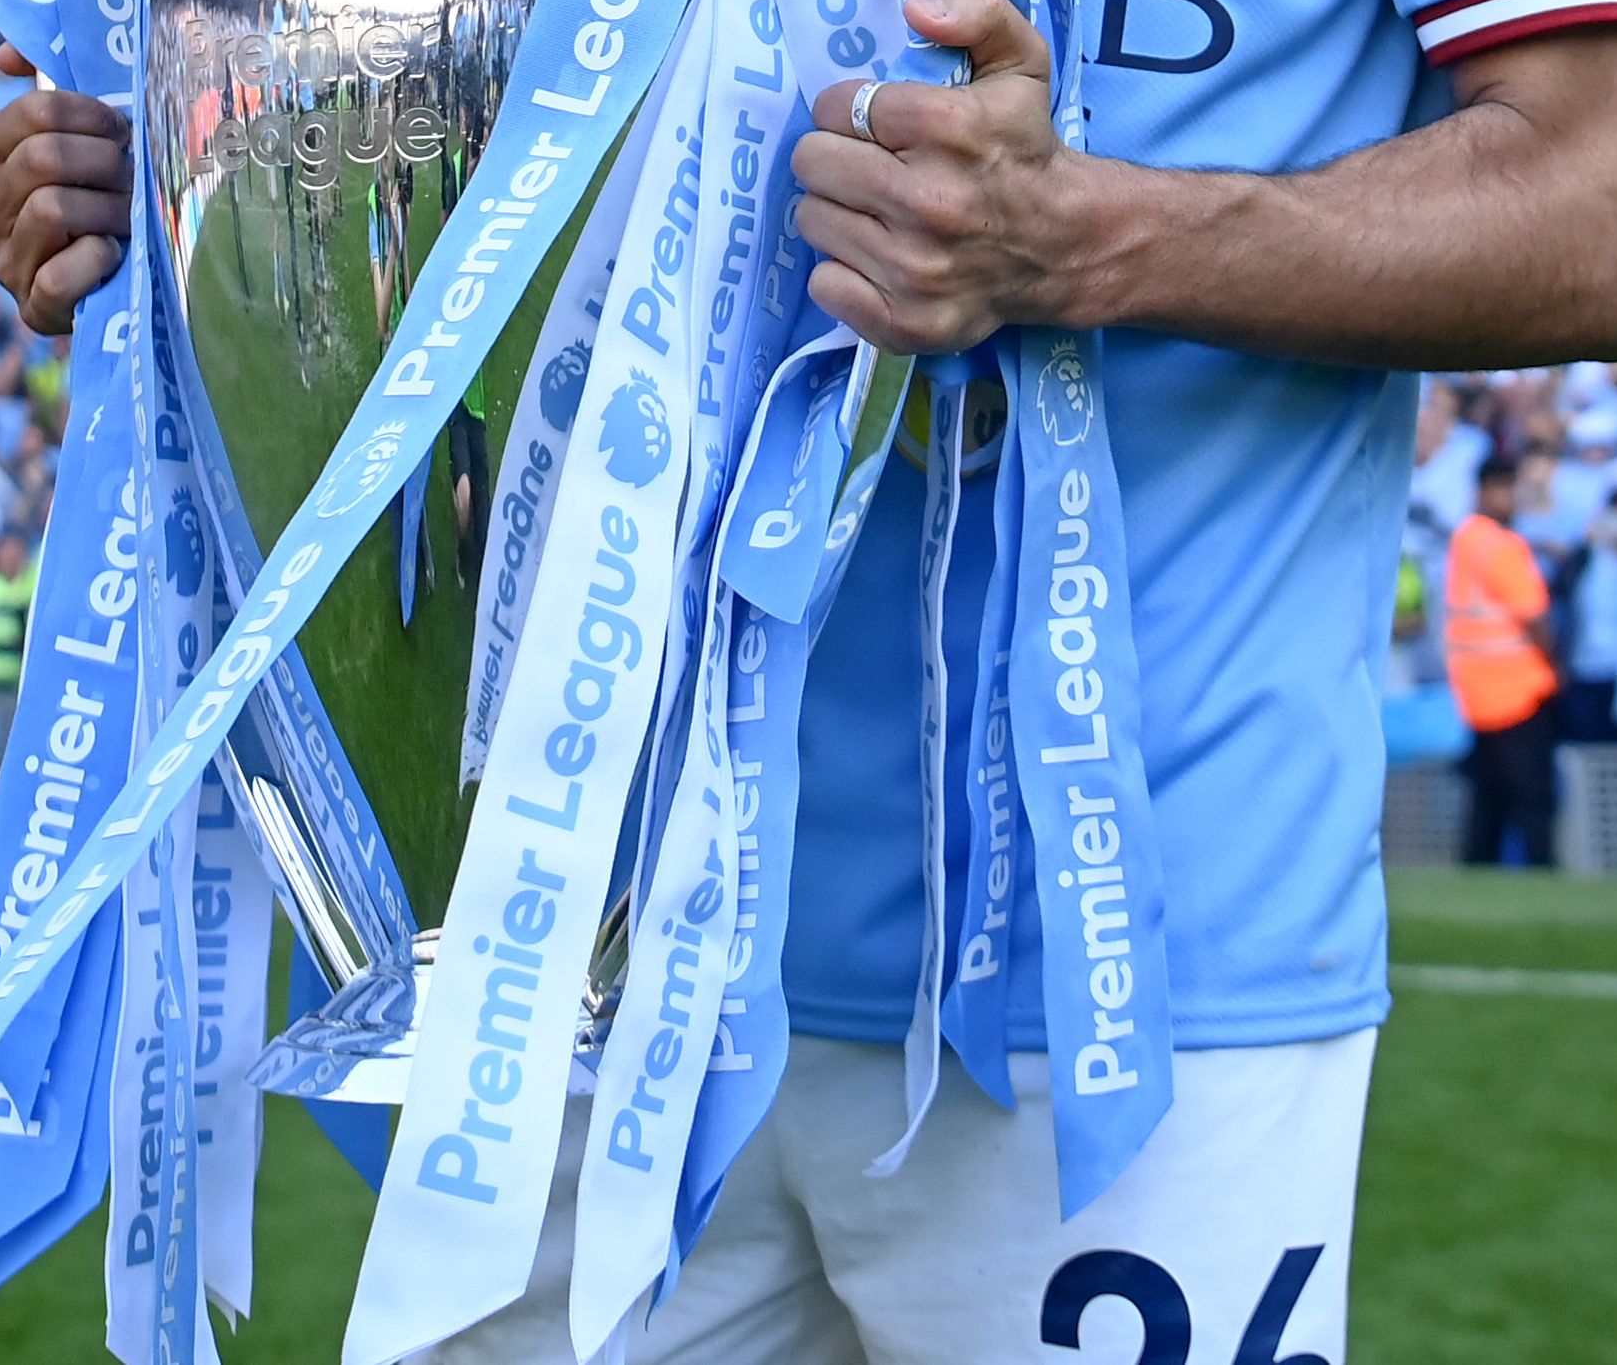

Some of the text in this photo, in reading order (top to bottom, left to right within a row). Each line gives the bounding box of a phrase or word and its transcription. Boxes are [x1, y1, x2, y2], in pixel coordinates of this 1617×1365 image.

[184, 4, 441, 87] Premier
[188, 104, 447, 191] League
[382, 132, 574, 397] Premier
[620, 115, 704, 356] Premi
[697, 110, 766, 418] Premier
[102, 541, 324, 840] League
[1041, 468, 1139, 1096] Premier League
[416, 504, 644, 1205] Premier League
[607, 839, 725, 1173] Premier
